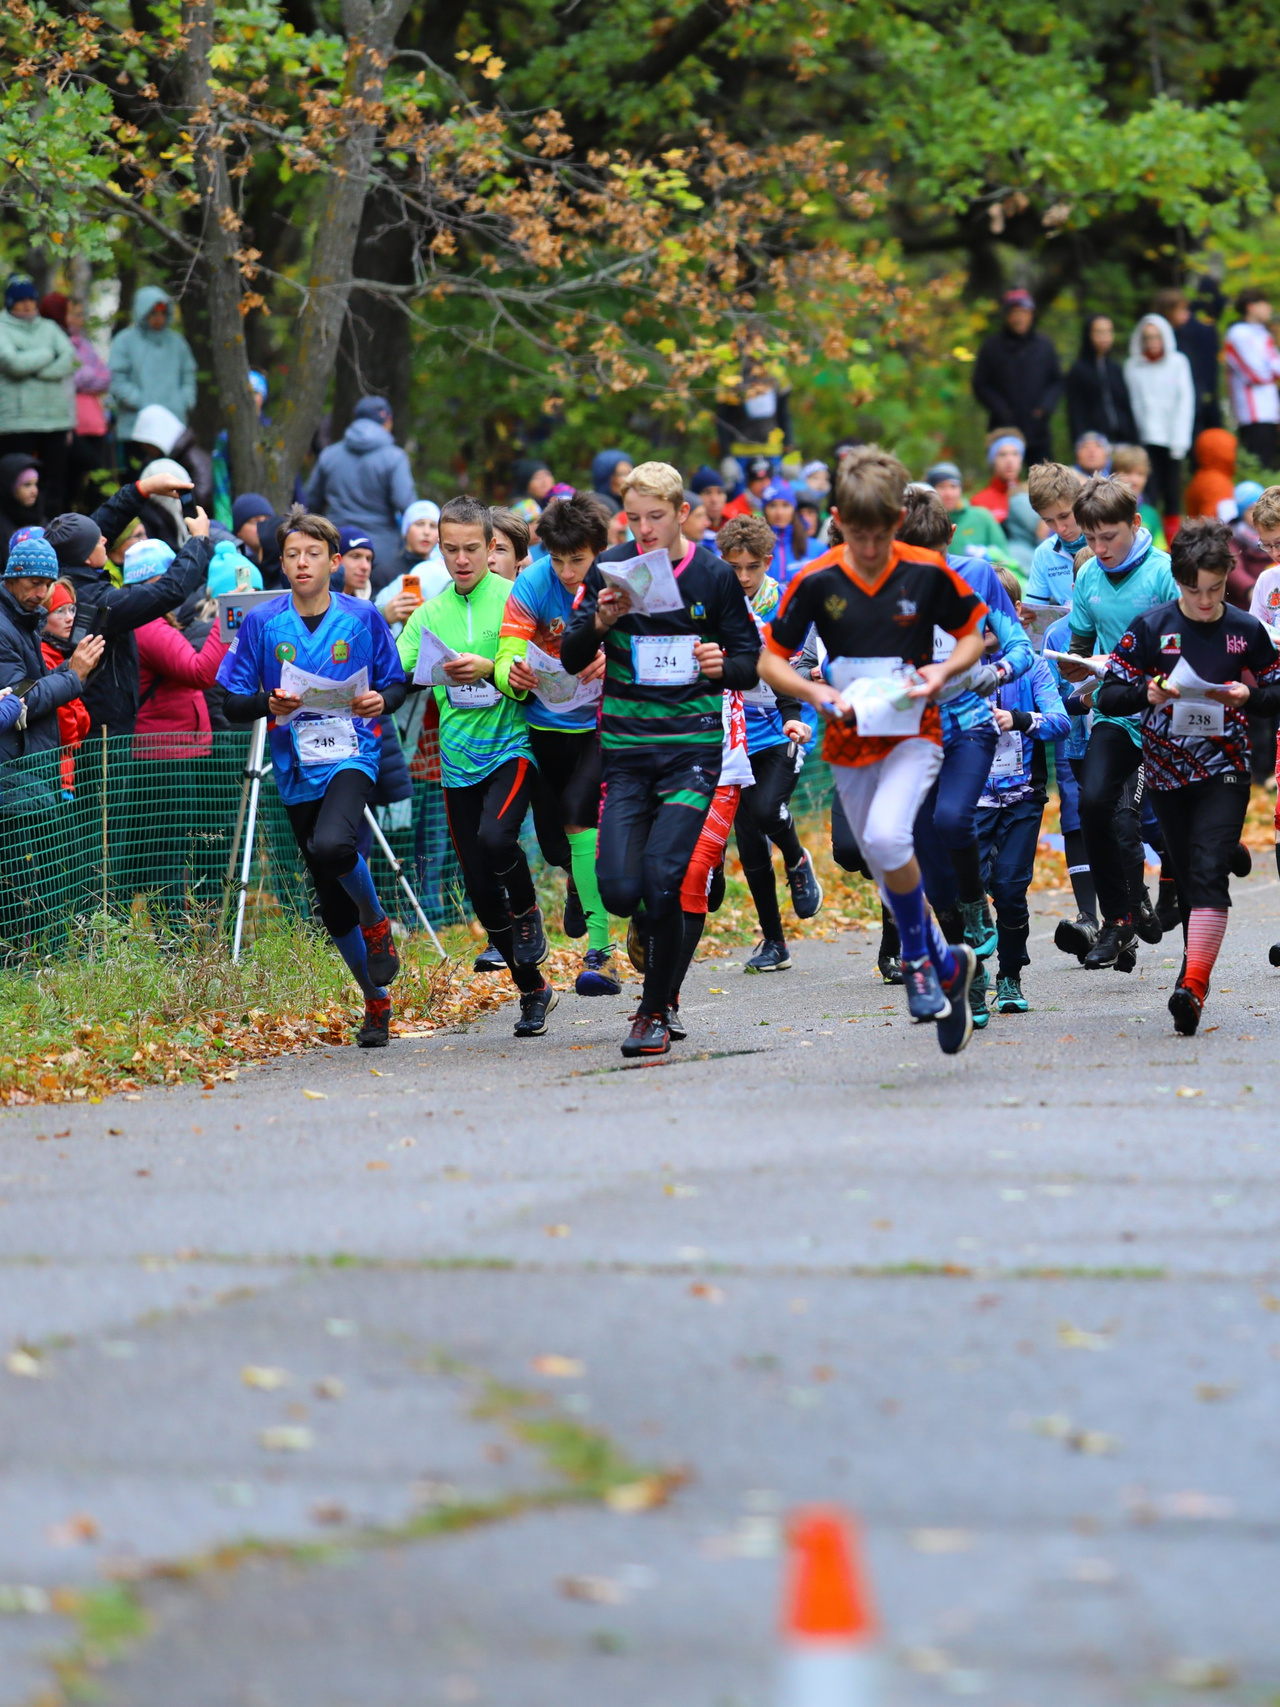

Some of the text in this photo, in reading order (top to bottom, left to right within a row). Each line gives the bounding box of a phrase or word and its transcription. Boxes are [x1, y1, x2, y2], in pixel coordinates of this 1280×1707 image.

[654, 656, 677, 668] 234
[1188, 714, 1211, 726] 238
[313, 737, 336, 749] 248
